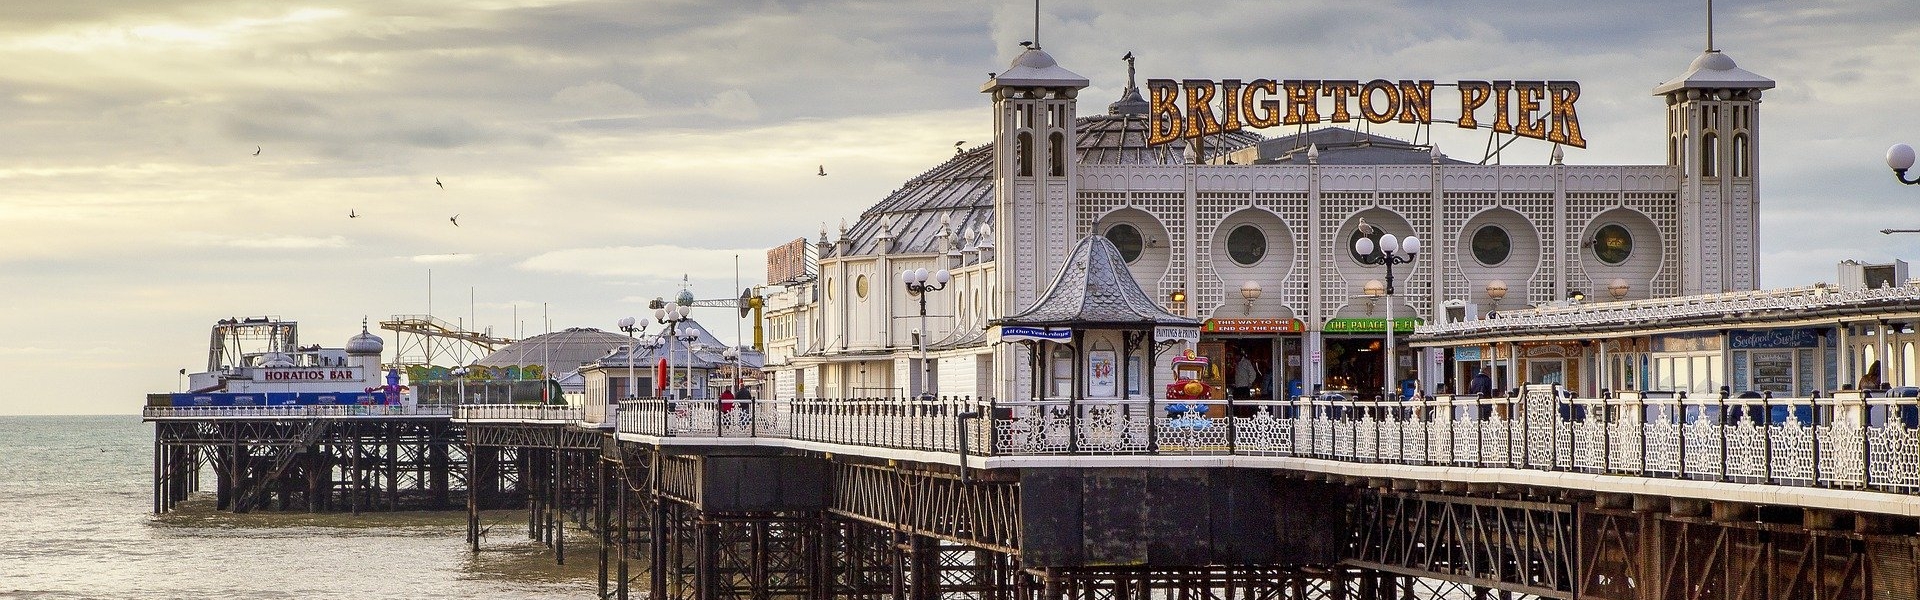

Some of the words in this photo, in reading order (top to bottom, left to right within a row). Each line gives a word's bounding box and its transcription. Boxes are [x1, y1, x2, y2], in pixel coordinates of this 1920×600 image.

[1147, 78, 1435, 149] BRIGHTON
[1457, 79, 1587, 149] PIER
[254, 325, 290, 336] RIVR
[1330, 321, 1347, 329] THE
[1351, 321, 1385, 330] PALACE
[1178, 328, 1182, 338] &
[1183, 329, 1198, 339] PRINTS
[1732, 330, 1772, 348] Seafood
[1773, 328, 1800, 346] Sushi
[265, 371, 325, 380] HORATIOS
[329, 370, 353, 379] BAR
